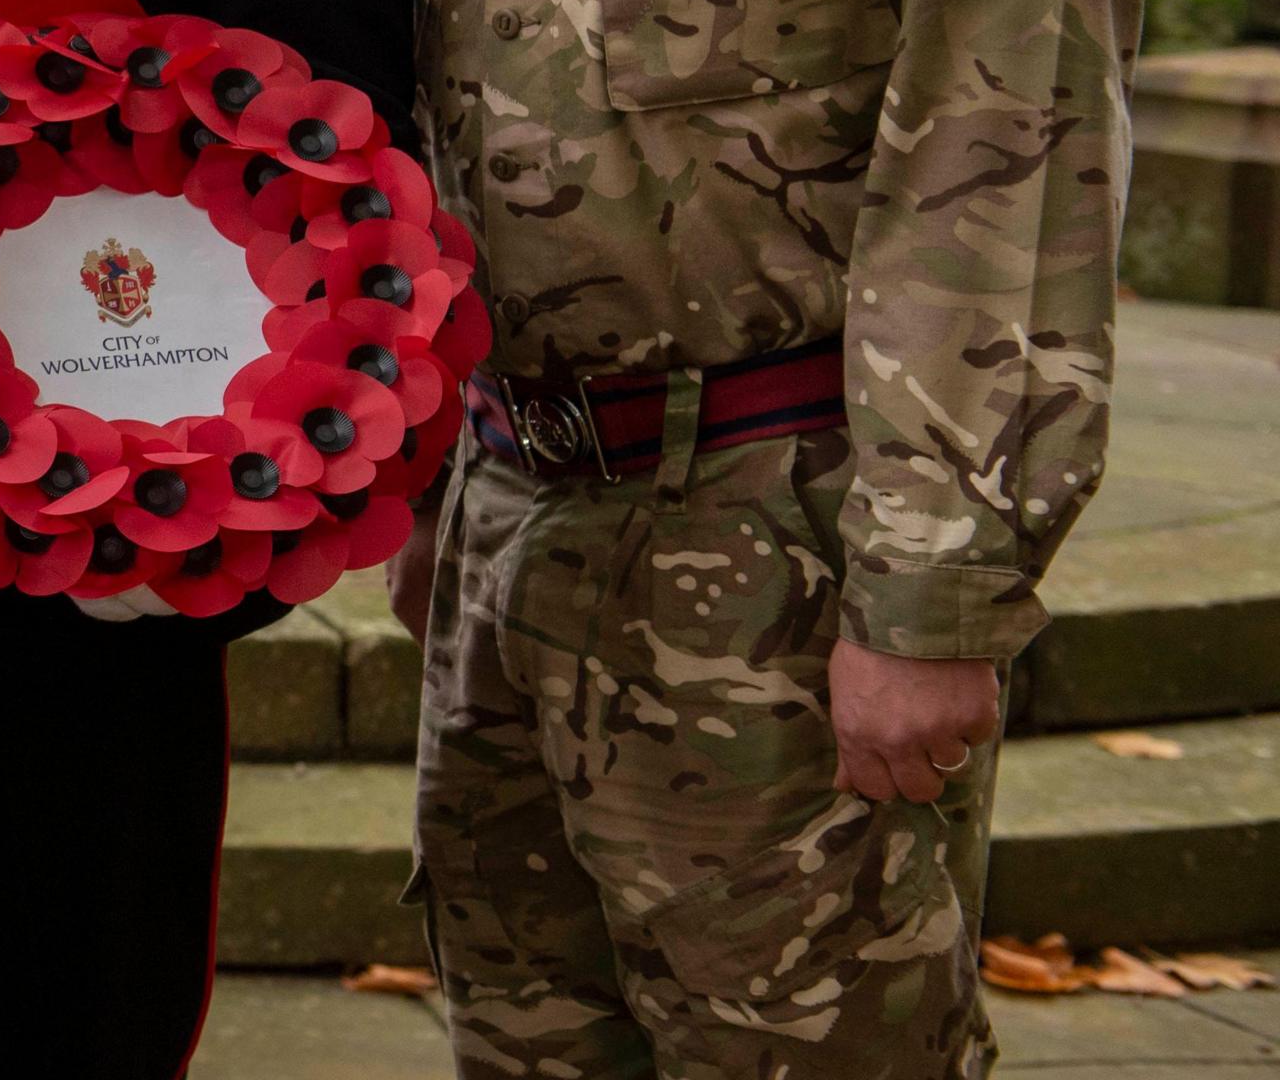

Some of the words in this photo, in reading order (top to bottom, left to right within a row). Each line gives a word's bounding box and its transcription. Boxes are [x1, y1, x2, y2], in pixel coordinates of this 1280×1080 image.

[102, 335, 142, 352] CITY
[146, 335, 161, 346] OF
[40, 346, 230, 375] WOLVERHAMPTON
